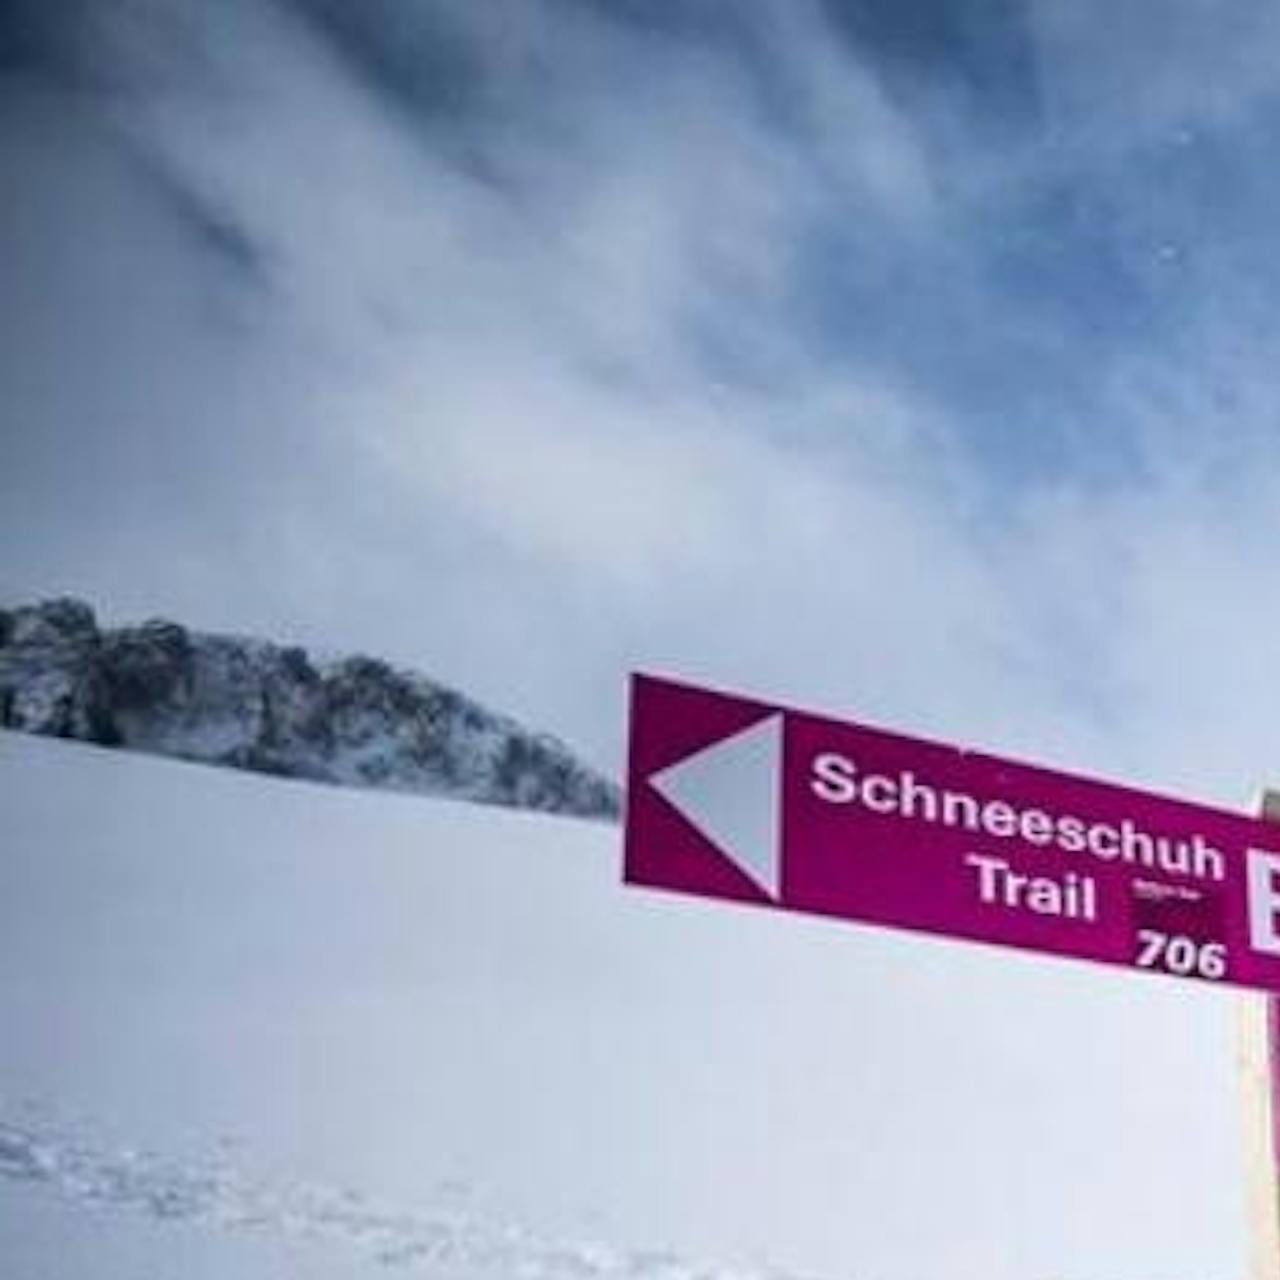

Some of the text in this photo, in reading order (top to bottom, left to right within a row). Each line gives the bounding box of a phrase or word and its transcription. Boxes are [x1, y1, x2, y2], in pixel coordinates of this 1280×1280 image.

[810, 753, 1224, 880] Schneeschuh
[964, 854, 1096, 921] Trail
[1136, 929, 1227, 979] 706
